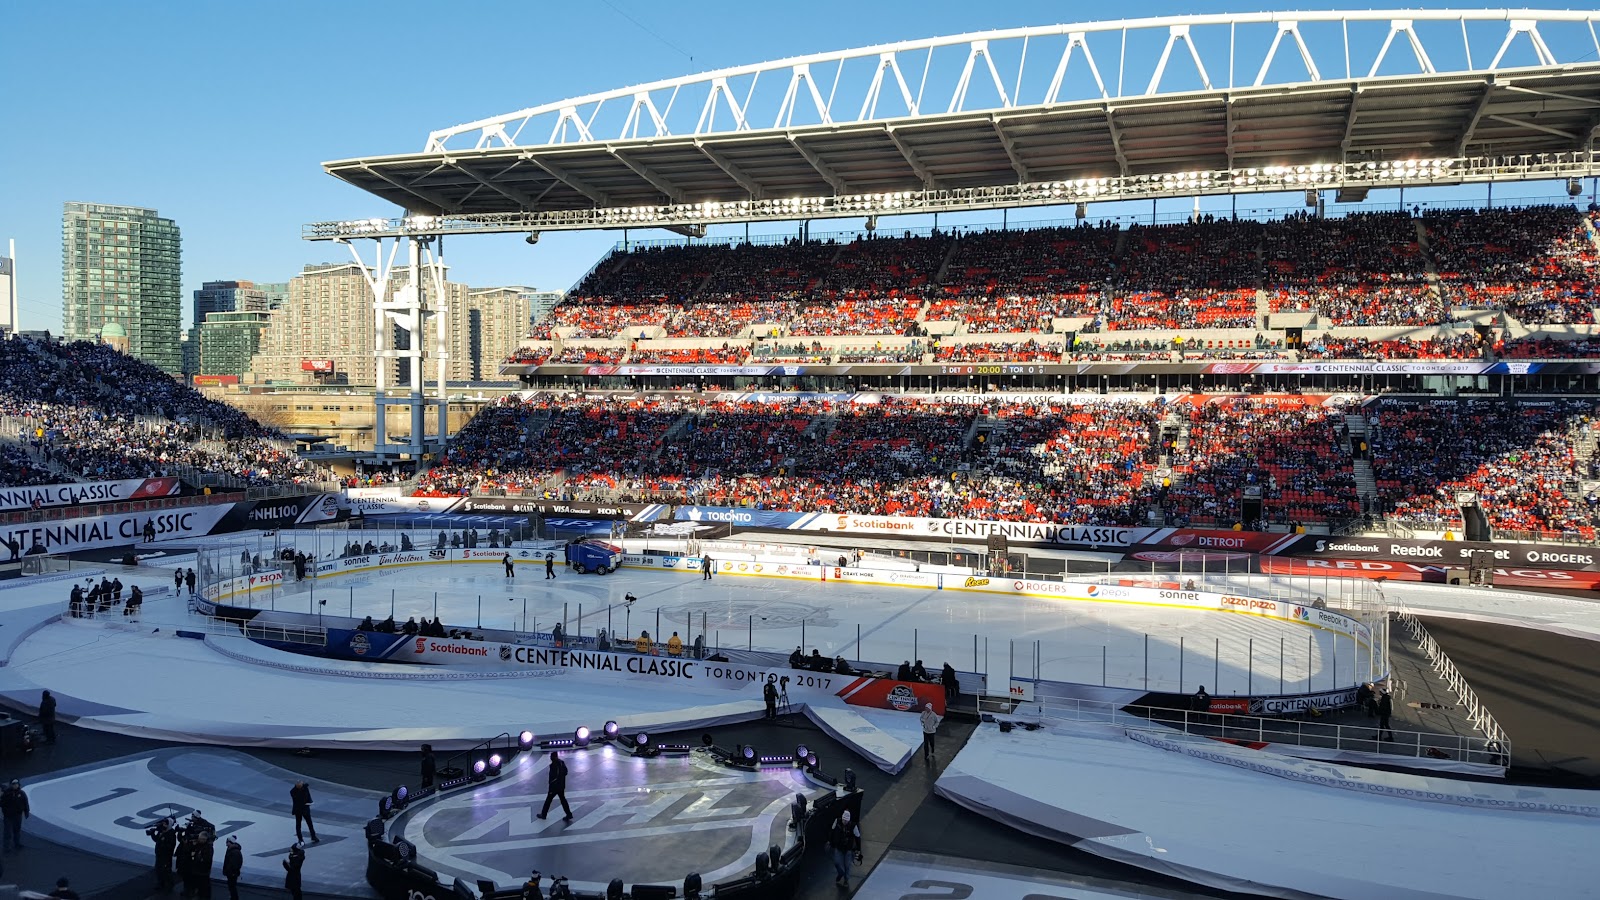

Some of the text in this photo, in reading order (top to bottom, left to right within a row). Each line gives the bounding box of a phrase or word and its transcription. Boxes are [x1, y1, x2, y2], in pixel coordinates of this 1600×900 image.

[248, 504, 298, 521] #NHL100
[707, 512, 752, 522] TORONTO
[119, 513, 192, 538] CLSSIC
[853, 518, 914, 530] Scotiabank
[943, 520, 1054, 544] CENTENNIAL
[1199, 536, 1245, 548] DETROIT
[1328, 543, 1379, 552] Scotiabank
[1390, 544, 1442, 557] Reebok
[344, 556, 370, 566] sonnet
[379, 555, 392, 566] Tim
[664, 558, 676, 566] SAP
[687, 560, 700, 568] SAP
[1542, 552, 1593, 564] ROGERS
[1306, 559, 1393, 570] RED
[1026, 583, 1066, 593] ROGERS
[1102, 588, 1129, 597] pepsi
[1159, 590, 1199, 600] sonnet
[1221, 596, 1276, 610] pizza pizza
[1319, 612, 1342, 625] Reebok
[430, 642, 488, 656] Scotiabank
[515, 648, 622, 671] CENTENNIAL
[705, 667, 778, 684] TORONTO
[797, 676, 831, 689] 2017
[1266, 692, 1356, 712] CENTENNIAL CLASS
[1187, 749, 1200, 757] 100
[1233, 758, 1248, 767] 100
[1257, 764, 1272, 772] 100
[1282, 770, 1299, 778] 100
[1311, 775, 1327, 783] 100
[1338, 780, 1355, 788] 100
[1367, 784, 1384, 792] 100
